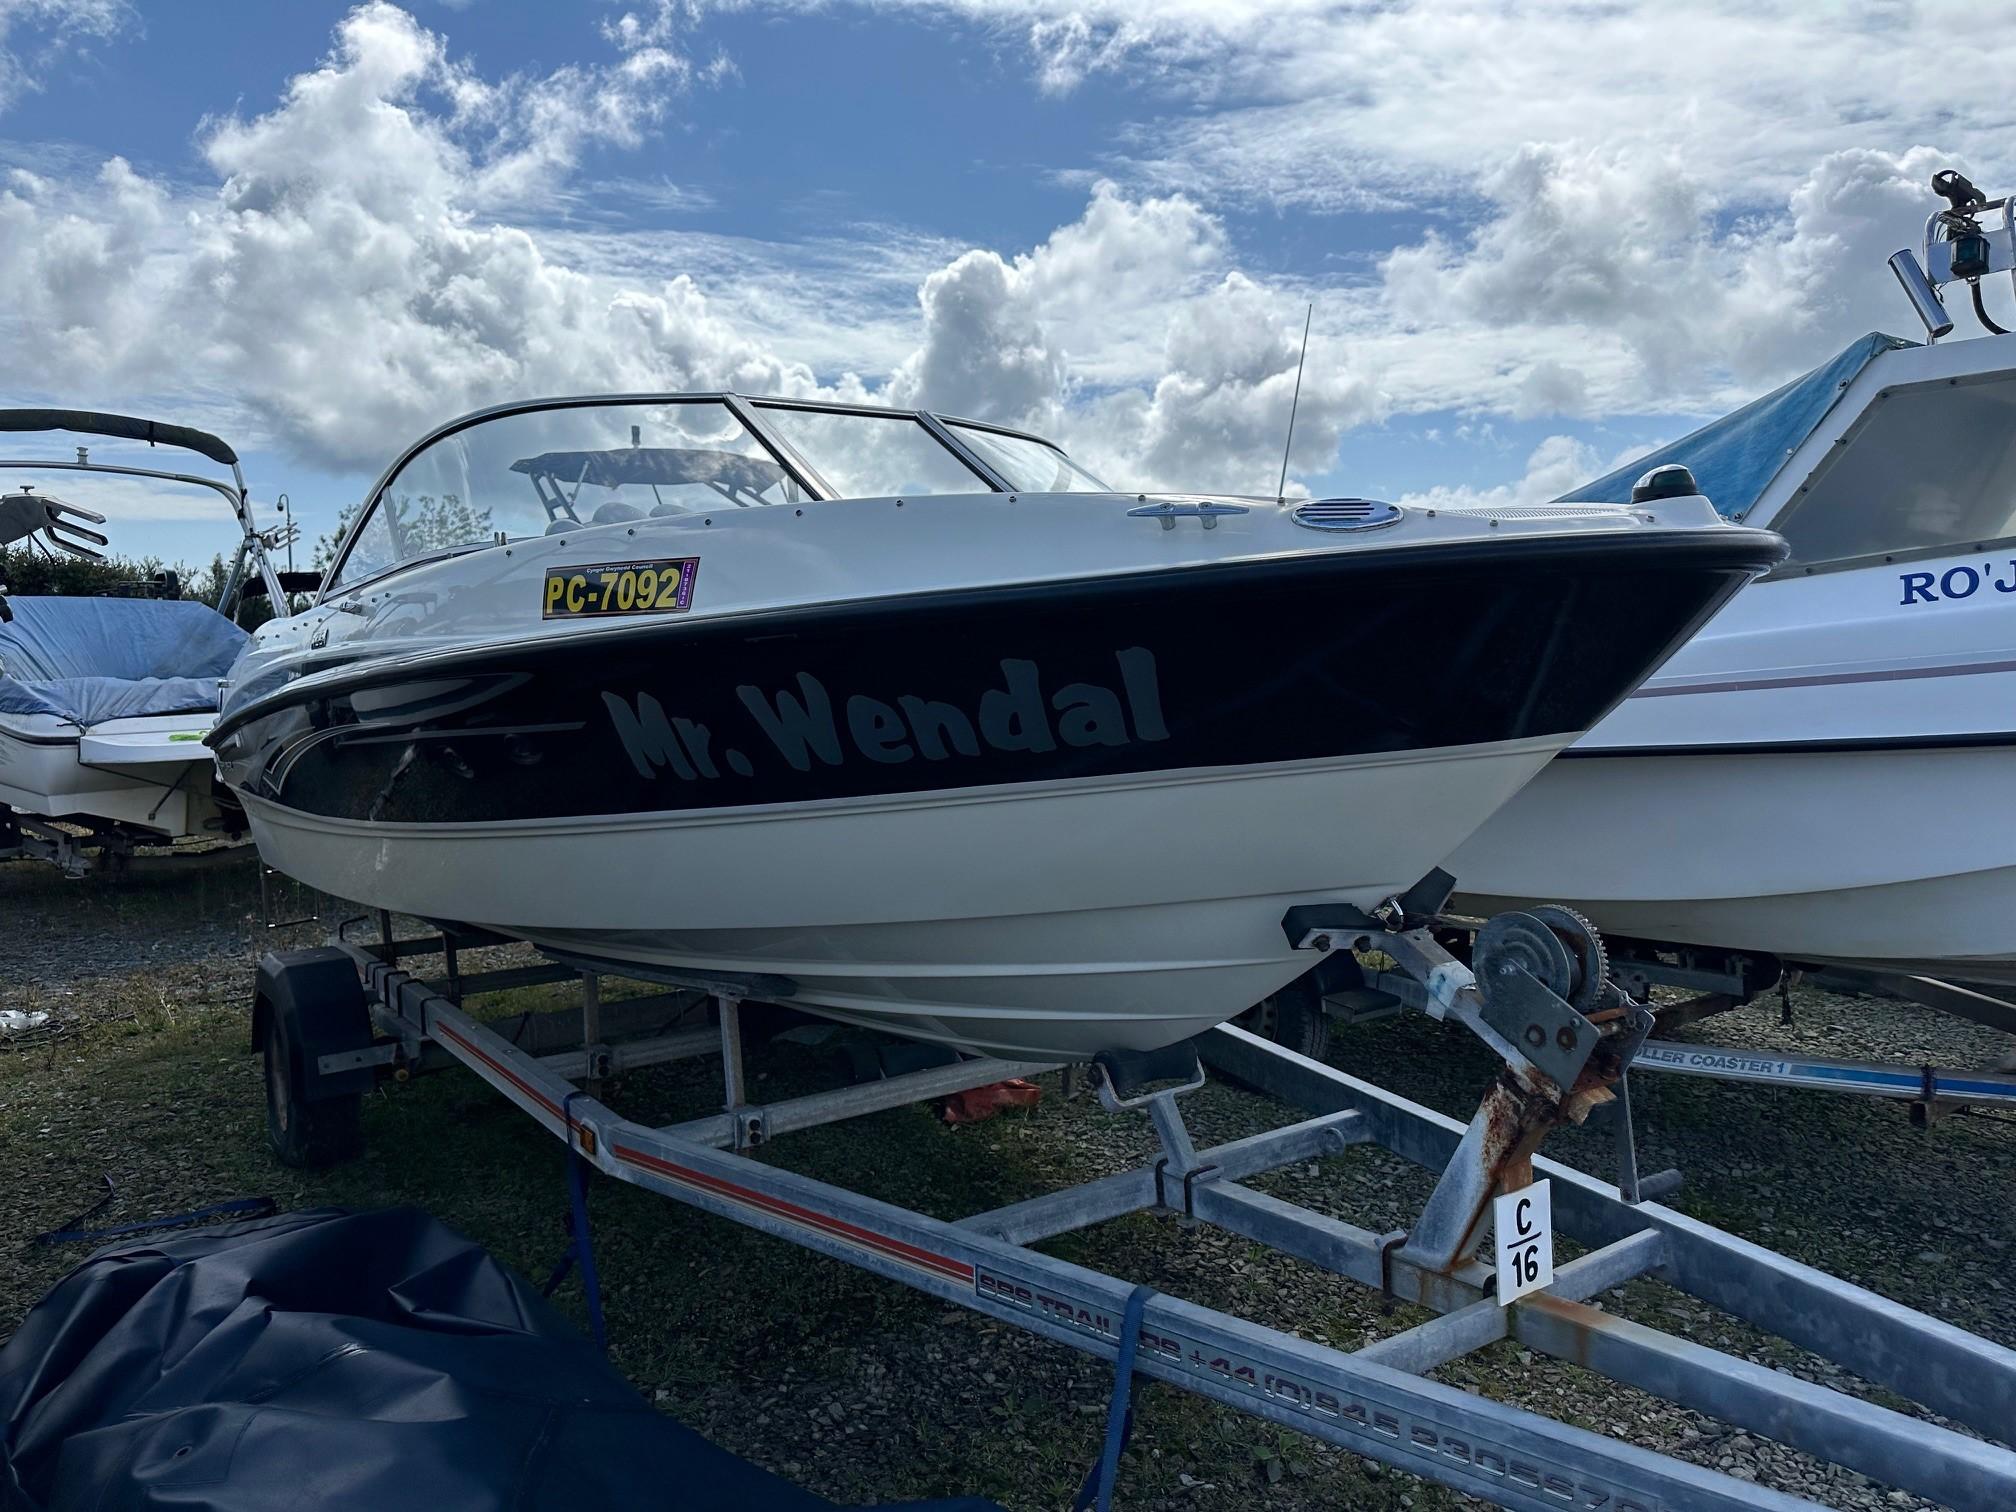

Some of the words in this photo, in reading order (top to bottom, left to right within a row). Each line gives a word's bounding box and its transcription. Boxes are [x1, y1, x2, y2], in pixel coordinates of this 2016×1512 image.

[546, 567, 681, 614] PC-7092
[601, 691, 754, 780] Mr.
[736, 646, 1170, 772] Wendal
[1689, 1054, 1774, 1074] COASTER
[1516, 1198, 1532, 1236] C
[1511, 1244, 1539, 1288] 16
[1037, 1293, 1182, 1363] TRAILRS
